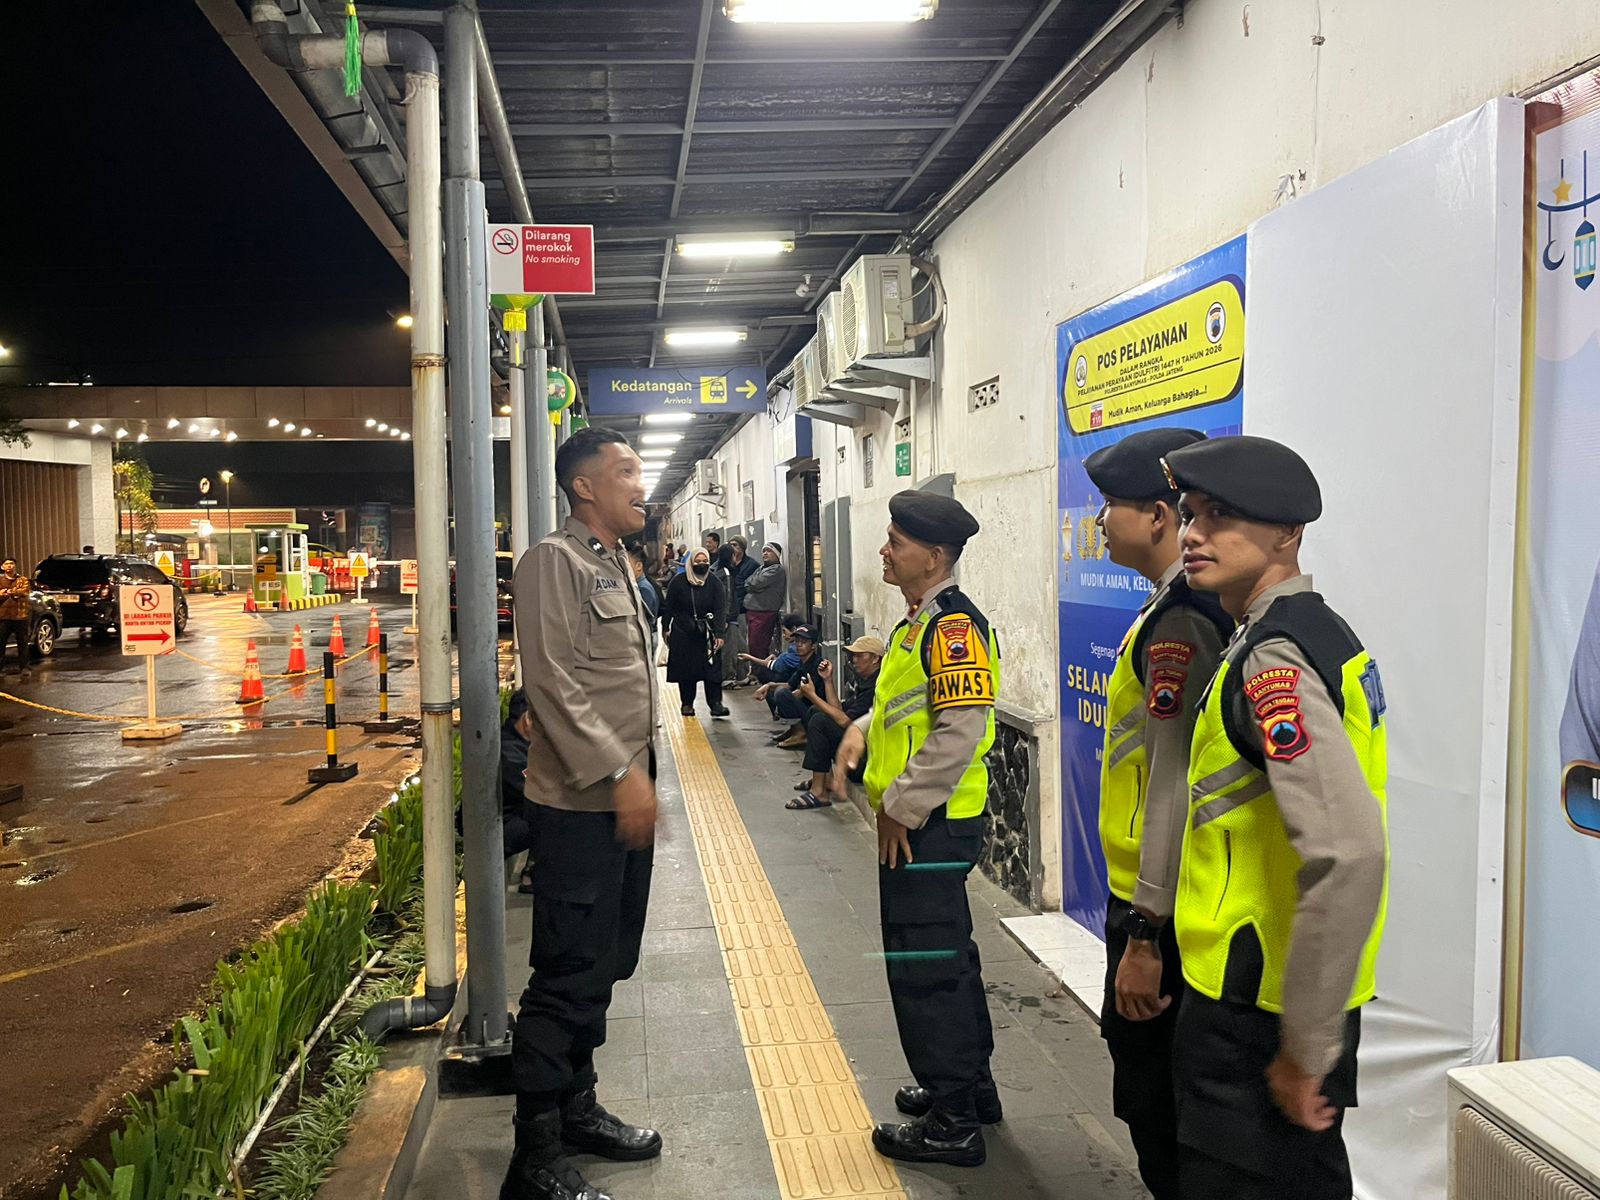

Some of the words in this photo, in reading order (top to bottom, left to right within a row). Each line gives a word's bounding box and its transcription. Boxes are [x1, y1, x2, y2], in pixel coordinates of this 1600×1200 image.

[525, 230, 571, 242] Dilarang
[525, 242, 573, 252] merokok
[525, 254, 540, 263] No
[541, 254, 581, 265] smoking
[1097, 349, 1117, 371] POS
[1120, 321, 1188, 363] PELAYANAN
[1077, 382, 1105, 396] PELAYANAN
[1106, 374, 1132, 388] PERAYAAN
[1133, 363, 1160, 379] IDULFITRI
[1160, 359, 1175, 371] 1447
[1175, 357, 1181, 366] H
[1181, 350, 1204, 363] TAHUN
[1204, 344, 1223, 356] 2026
[1120, 363, 1138, 376] DALAM
[1139, 355, 1163, 369] RANGKA
[611, 379, 692, 394] Kedatangan
[1104, 386, 1123, 395] POLRESTA
[1123, 379, 1147, 390] BANYUMAS
[1150, 372, 1164, 382] POLDA
[1165, 366, 1184, 377] JATENG
[663, 396, 692, 404] Arrivals
[1108, 407, 1123, 418] Mudik
[1124, 403, 1143, 415] Aman,
[1144, 396, 1171, 409] Keluarga
[1080, 572, 1105, 588] MUDIK
[1105, 574, 1132, 592] AMAN,
[1090, 642, 1116, 661] Segenap
[1150, 642, 1191, 653] POLRESTA
[931, 671, 983, 701] PAWAS
[1246, 669, 1294, 691] POLRESTA
[1253, 682, 1291, 698] BANYUMAS
